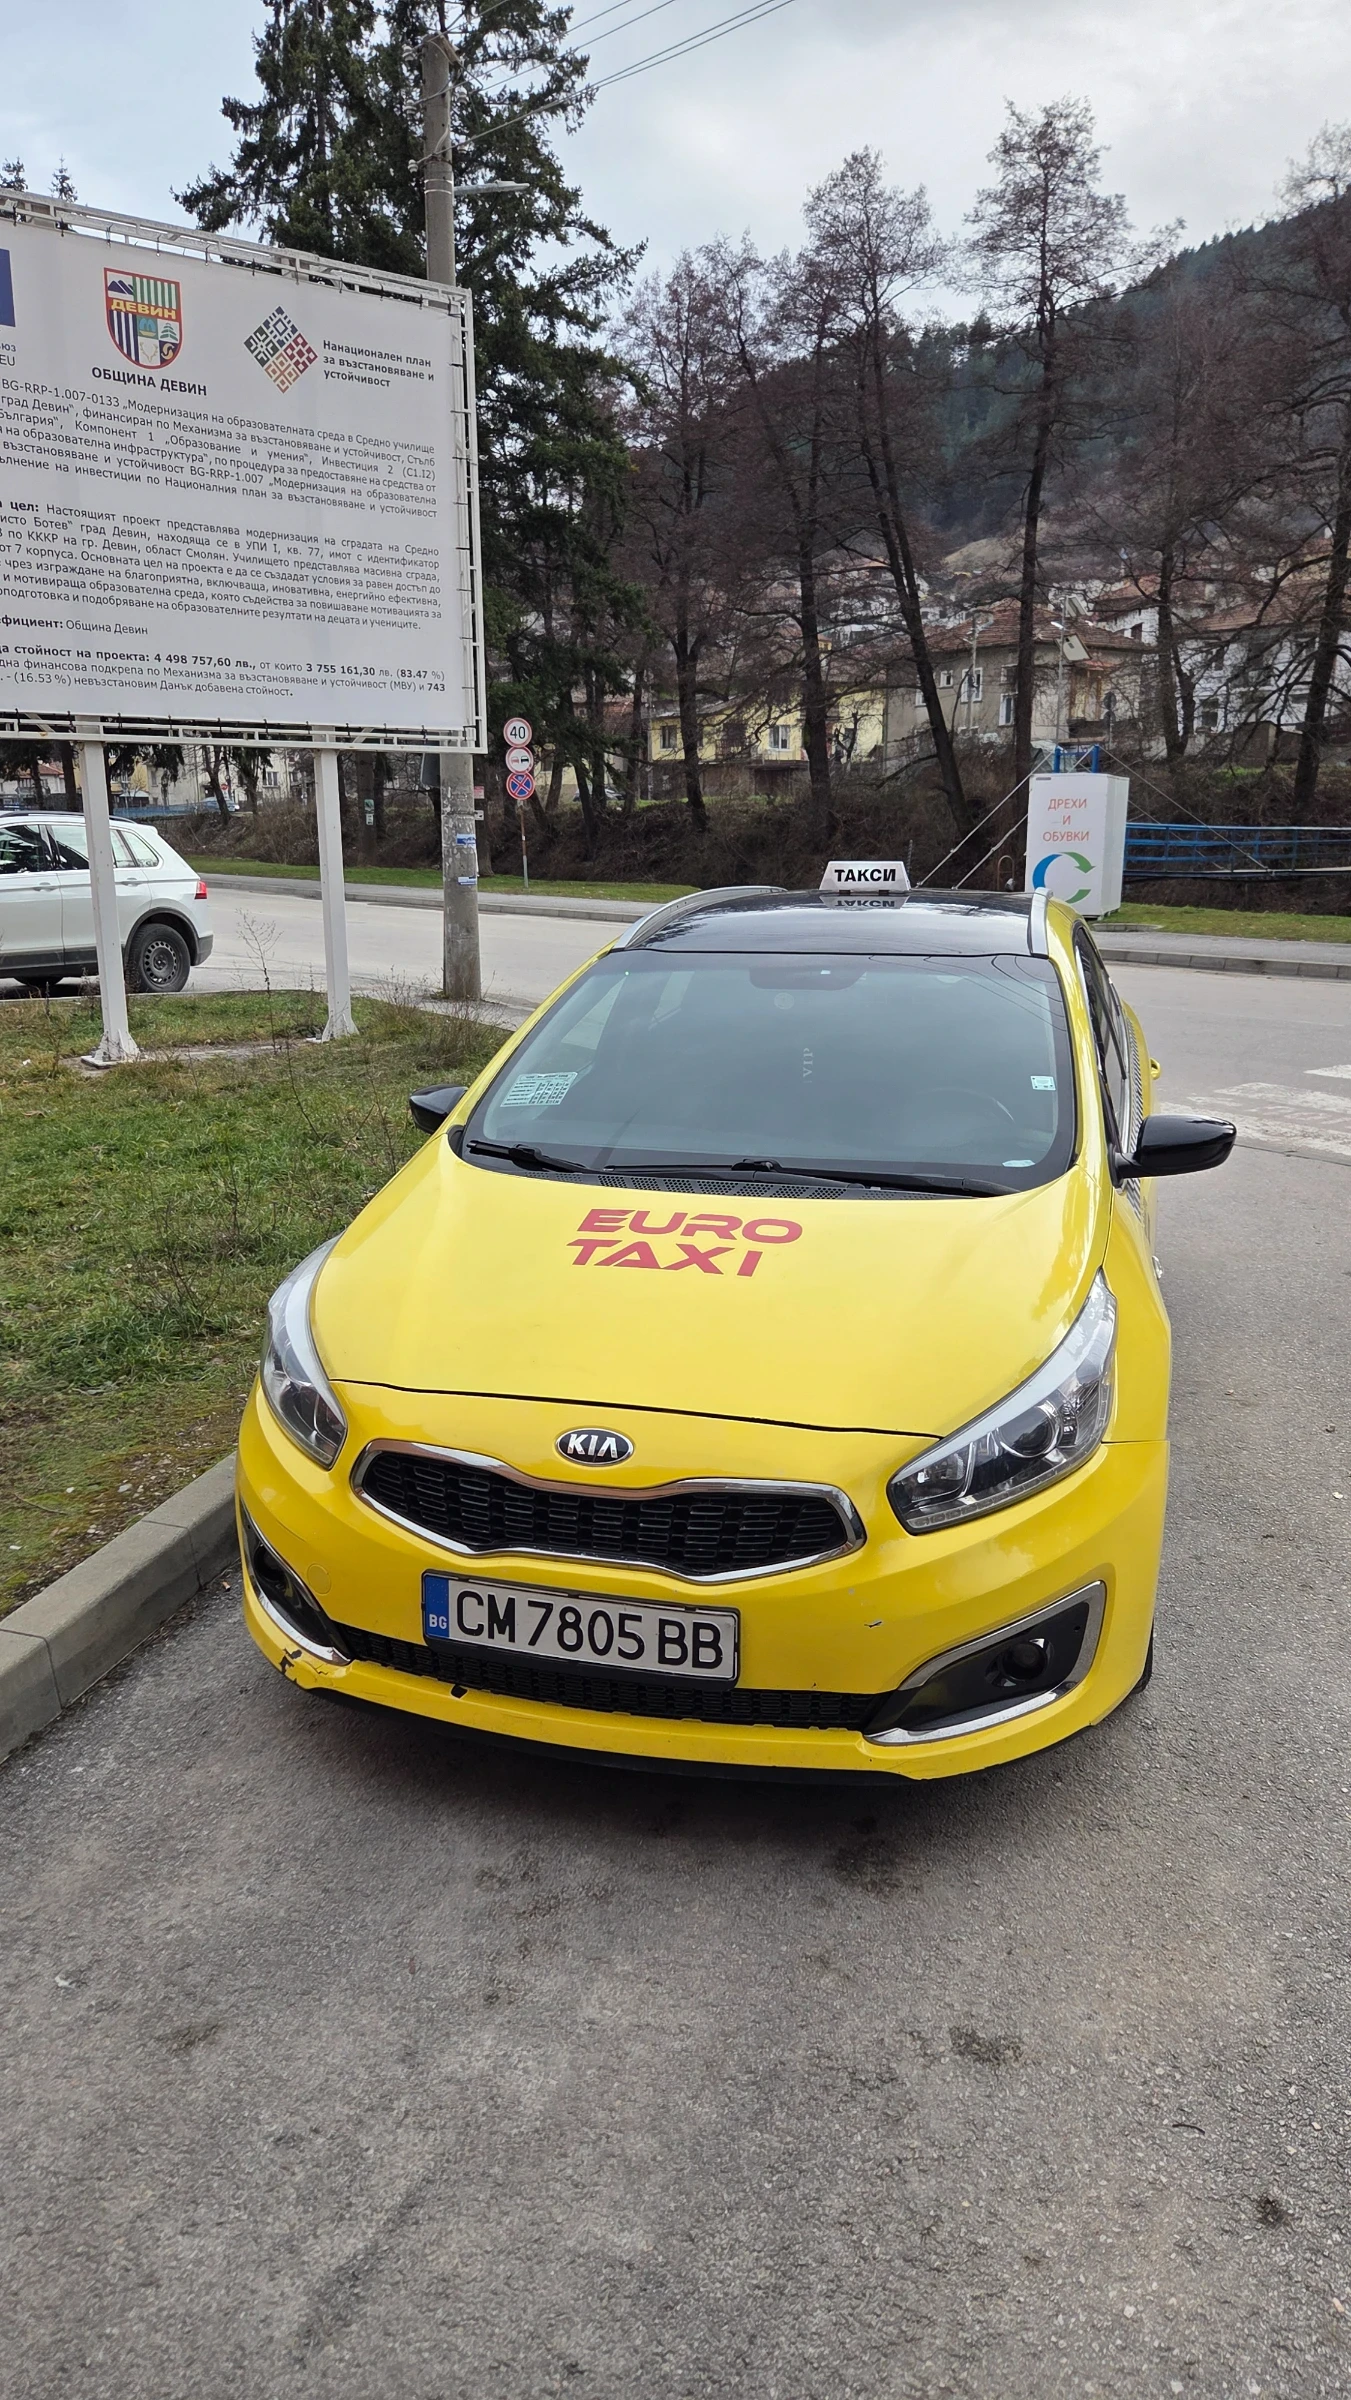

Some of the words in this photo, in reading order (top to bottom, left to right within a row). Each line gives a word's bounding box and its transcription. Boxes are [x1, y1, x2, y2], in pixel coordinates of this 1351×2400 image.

[111, 299, 176, 320] ДЕВИН
[323, 340, 402, 362] Нанационален
[406, 356, 431, 368] план
[323, 356, 335, 364] за
[339, 358, 424, 380] възстановяване
[92, 367, 156, 388] ОБЩИНА
[160, 378, 207, 396] ДЕВИН
[324, 370, 391, 387] устойчивост
[1, 378, 120, 408] BG-RRP-1.007-0133
[211, 414, 224, 424] на
[226, 415, 315, 437] образователната
[316, 430, 345, 442] среда
[355, 434, 391, 448] Средно
[392, 441, 434, 454] училище
[1, 395, 29, 409] град
[82, 406, 153, 427] финансиран
[156, 420, 170, 430] по
[173, 420, 232, 439] Механизма
[235, 432, 247, 441] за
[250, 434, 331, 453] възстановяване
[342, 447, 404, 464] устойчивост,
[406, 454, 435, 467] Стълб
[22, 427, 111, 450] образователна
[229, 458, 285, 475] процедура
[300, 468, 367, 484] предоставяне
[382, 478, 424, 491] средства
[74, 419, 137, 439] Компонент
[148, 431, 154, 442] 1
[321, 455, 378, 472] Инвестиция
[387, 464, 393, 474] 2
[2, 440, 98, 462] възстановяване
[116, 457, 185, 474] устойчивост
[189, 465, 264, 484] BG-RRP-1.007
[366, 488, 436, 505] образователна
[74, 465, 141, 482] инвестиции
[164, 475, 237, 494] Националния
[241, 487, 267, 498] план
[287, 493, 366, 510] възстановяване
[379, 504, 437, 518] устойчивост
[9, 501, 39, 512] цел:
[46, 503, 116, 522] Настоящият
[122, 514, 161, 527] проект
[166, 520, 240, 536] представлява
[246, 528, 319, 544] модернизация
[340, 539, 383, 550] сградата
[404, 544, 439, 556] Средно
[27, 530, 58, 543] КККР
[81, 538, 98, 549] гр.
[102, 538, 140, 554] Девин,
[145, 544, 182, 556] област
[185, 547, 228, 561] Смолян.
[232, 552, 290, 567] Училището
[293, 560, 360, 574] представлява
[363, 567, 402, 578] масивна
[405, 571, 440, 583] сграда,
[80, 524, 106, 536] град
[112, 525, 150, 542] Девин,
[156, 532, 210, 547] находяща
[245, 540, 267, 552] УПИ
[286, 546, 302, 555] кв.
[308, 546, 323, 559] 77,
[328, 550, 352, 560] имот
[367, 554, 440, 570] идентификатор
[4, 558, 32, 570] чрез
[35, 562, 105, 578] изграждане
[124, 568, 203, 587] благоприятна,
[206, 578, 269, 593] включваща,
[271, 584, 333, 599] иновативна,
[336, 590, 386, 602] енергийно
[387, 593, 441, 608] ефективна,
[16, 543, 22, 554] 7
[25, 546, 78, 560] корпуса.
[80, 550, 140, 566] Основната
[143, 558, 163, 569] цел
[181, 562, 224, 574] проекта
[263, 570, 310, 583] създадат
[311, 575, 351, 586] условия
[365, 580, 393, 590] равен
[394, 583, 427, 592] достъп
[13, 574, 86, 590] мотивираща
[88, 579, 172, 596] образователна
[173, 589, 208, 601] среда,
[210, 592, 240, 602] която
[242, 594, 294, 607] съдейства
[309, 600, 369, 613] повишаване
[370, 606, 429, 618] мотивацията
[81, 594, 154, 608] подобряване
[170, 600, 260, 617] образователните
[262, 610, 312, 621] резултати
[327, 615, 360, 625] децата
[368, 618, 421, 630] учениците.
[65, 619, 112, 632] Община
[113, 623, 148, 635] Девин
[13, 644, 72, 657] стойност
[95, 651, 150, 662] проекта:
[153, 653, 162, 663] 4
[165, 653, 188, 664] 498
[191, 655, 231, 668] 757,60
[234, 660, 256, 670] лв.,
[274, 662, 303, 672] които
[305, 662, 313, 672] 3
[316, 663, 336, 674] 755
[340, 665, 375, 677] 161,30
[378, 669, 393, 677] лв.
[396, 668, 428, 679] (83.47
[23, 657, 87, 672] финансова
[90, 664, 143, 676] подкрепа
[163, 666, 222, 680] Механизма
[238, 673, 318, 685] възстановяване
[329, 677, 387, 689] устойчивост
[389, 680, 416, 692] (МВУ)
[426, 682, 445, 692] 743
[13, 671, 52, 684] (16.53
[73, 676, 158, 689] невъзстановим
[159, 679, 194, 691] Данък
[194, 682, 244, 694] добавена
[245, 685, 293, 696] стойност.
[510, 726, 526, 739] 40
[1048, 799, 1087, 810] ДРЕХИ
[1062, 815, 1071, 825] И
[1042, 831, 1090, 842] ОБУВКИ
[834, 868, 896, 882] ТАКСИ
[576, 1208, 802, 1244] EURO
[566, 1238, 763, 1277] TAXI
[566, 1434, 618, 1458] KIA
[429, 1614, 448, 1630] BG
